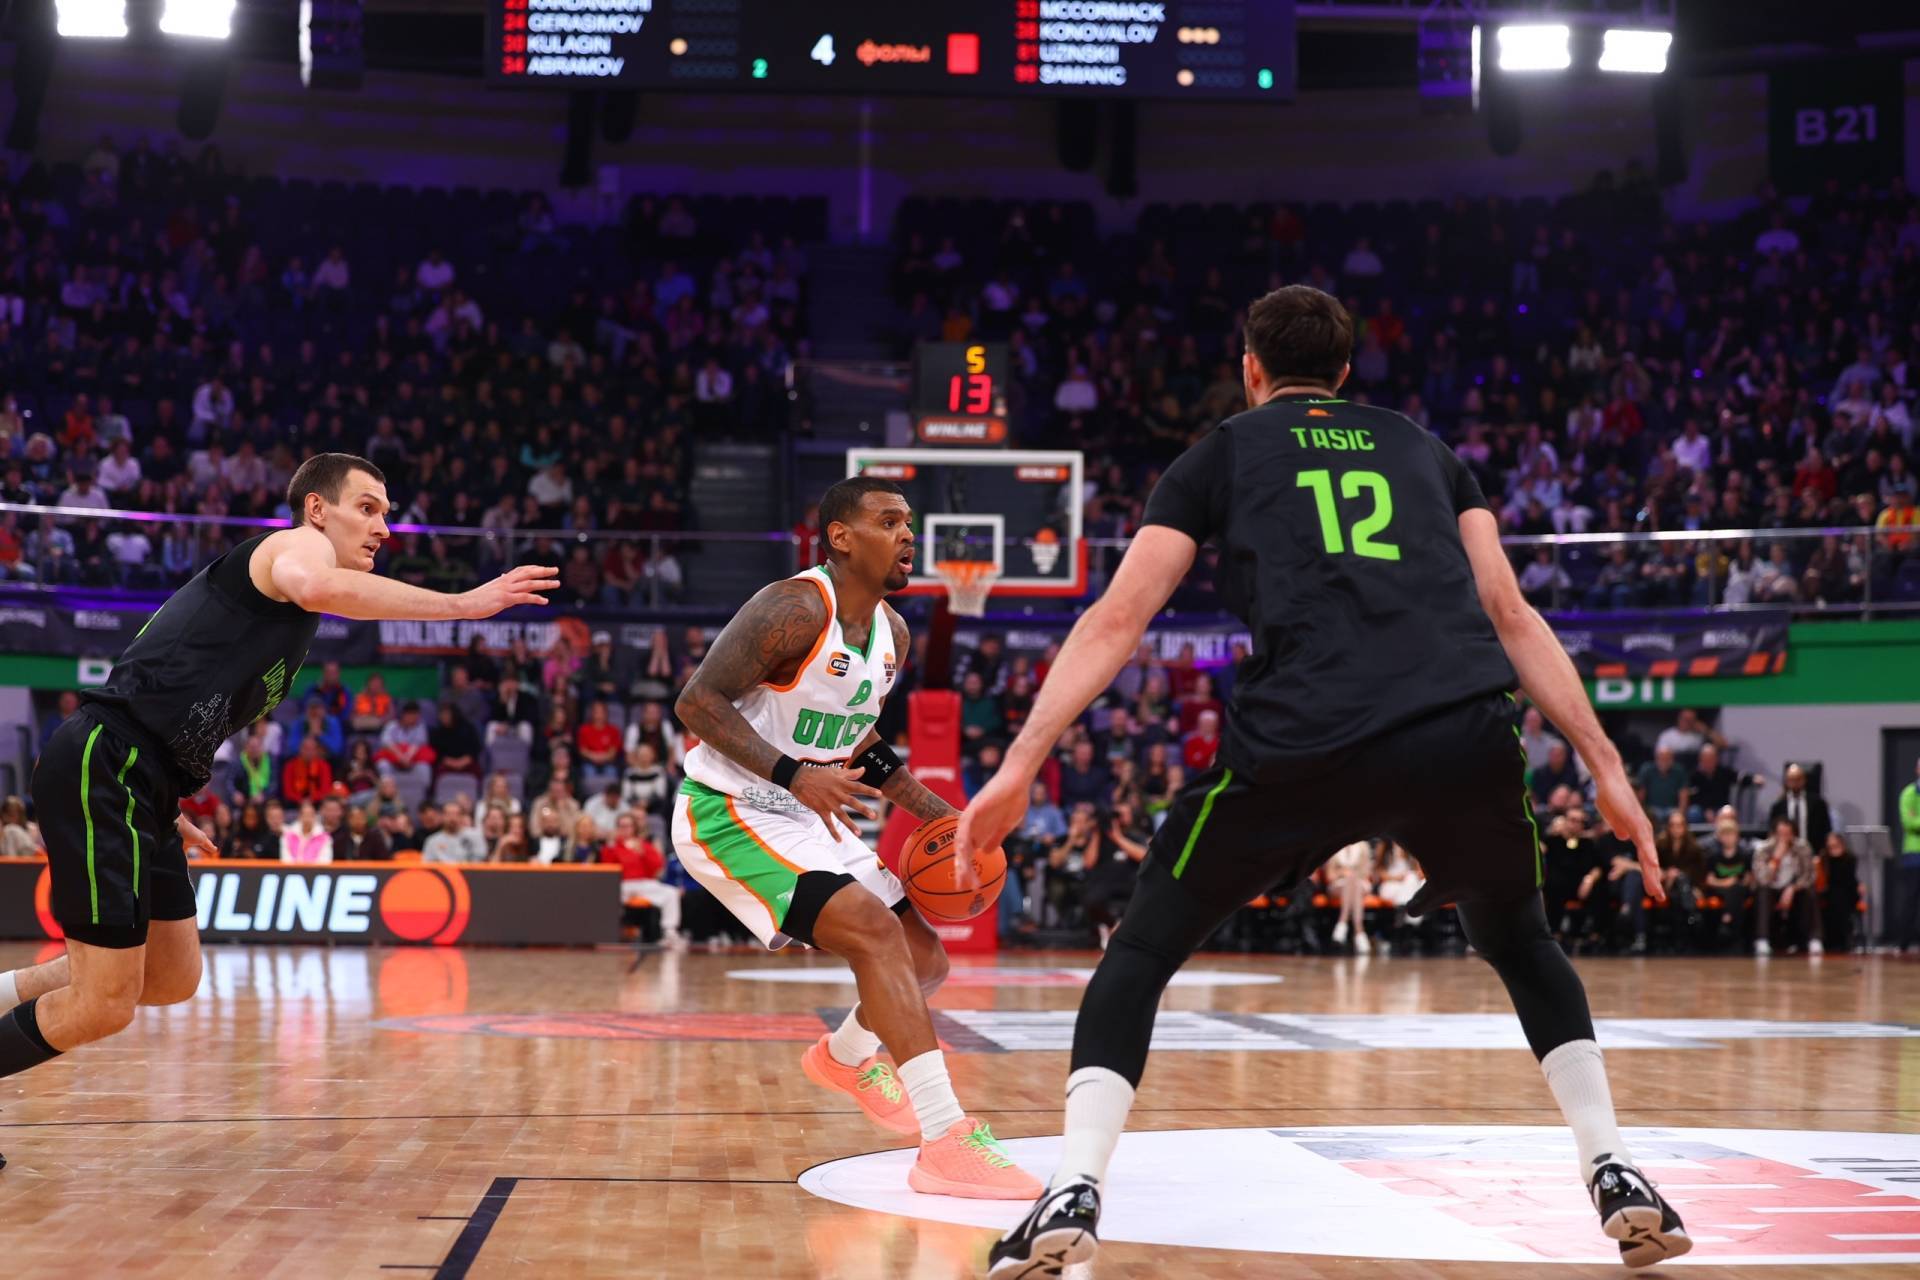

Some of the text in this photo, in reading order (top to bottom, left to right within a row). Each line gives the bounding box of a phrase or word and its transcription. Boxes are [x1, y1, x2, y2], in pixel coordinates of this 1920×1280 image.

[811, 34, 836, 66] 4
[1039, 22, 1158, 43] KONOVALOV
[949, 374, 992, 414] 13
[1290, 428, 1376, 450] TASIC
[1296, 469, 1401, 561] 12
[196, 872, 378, 932] LINE
